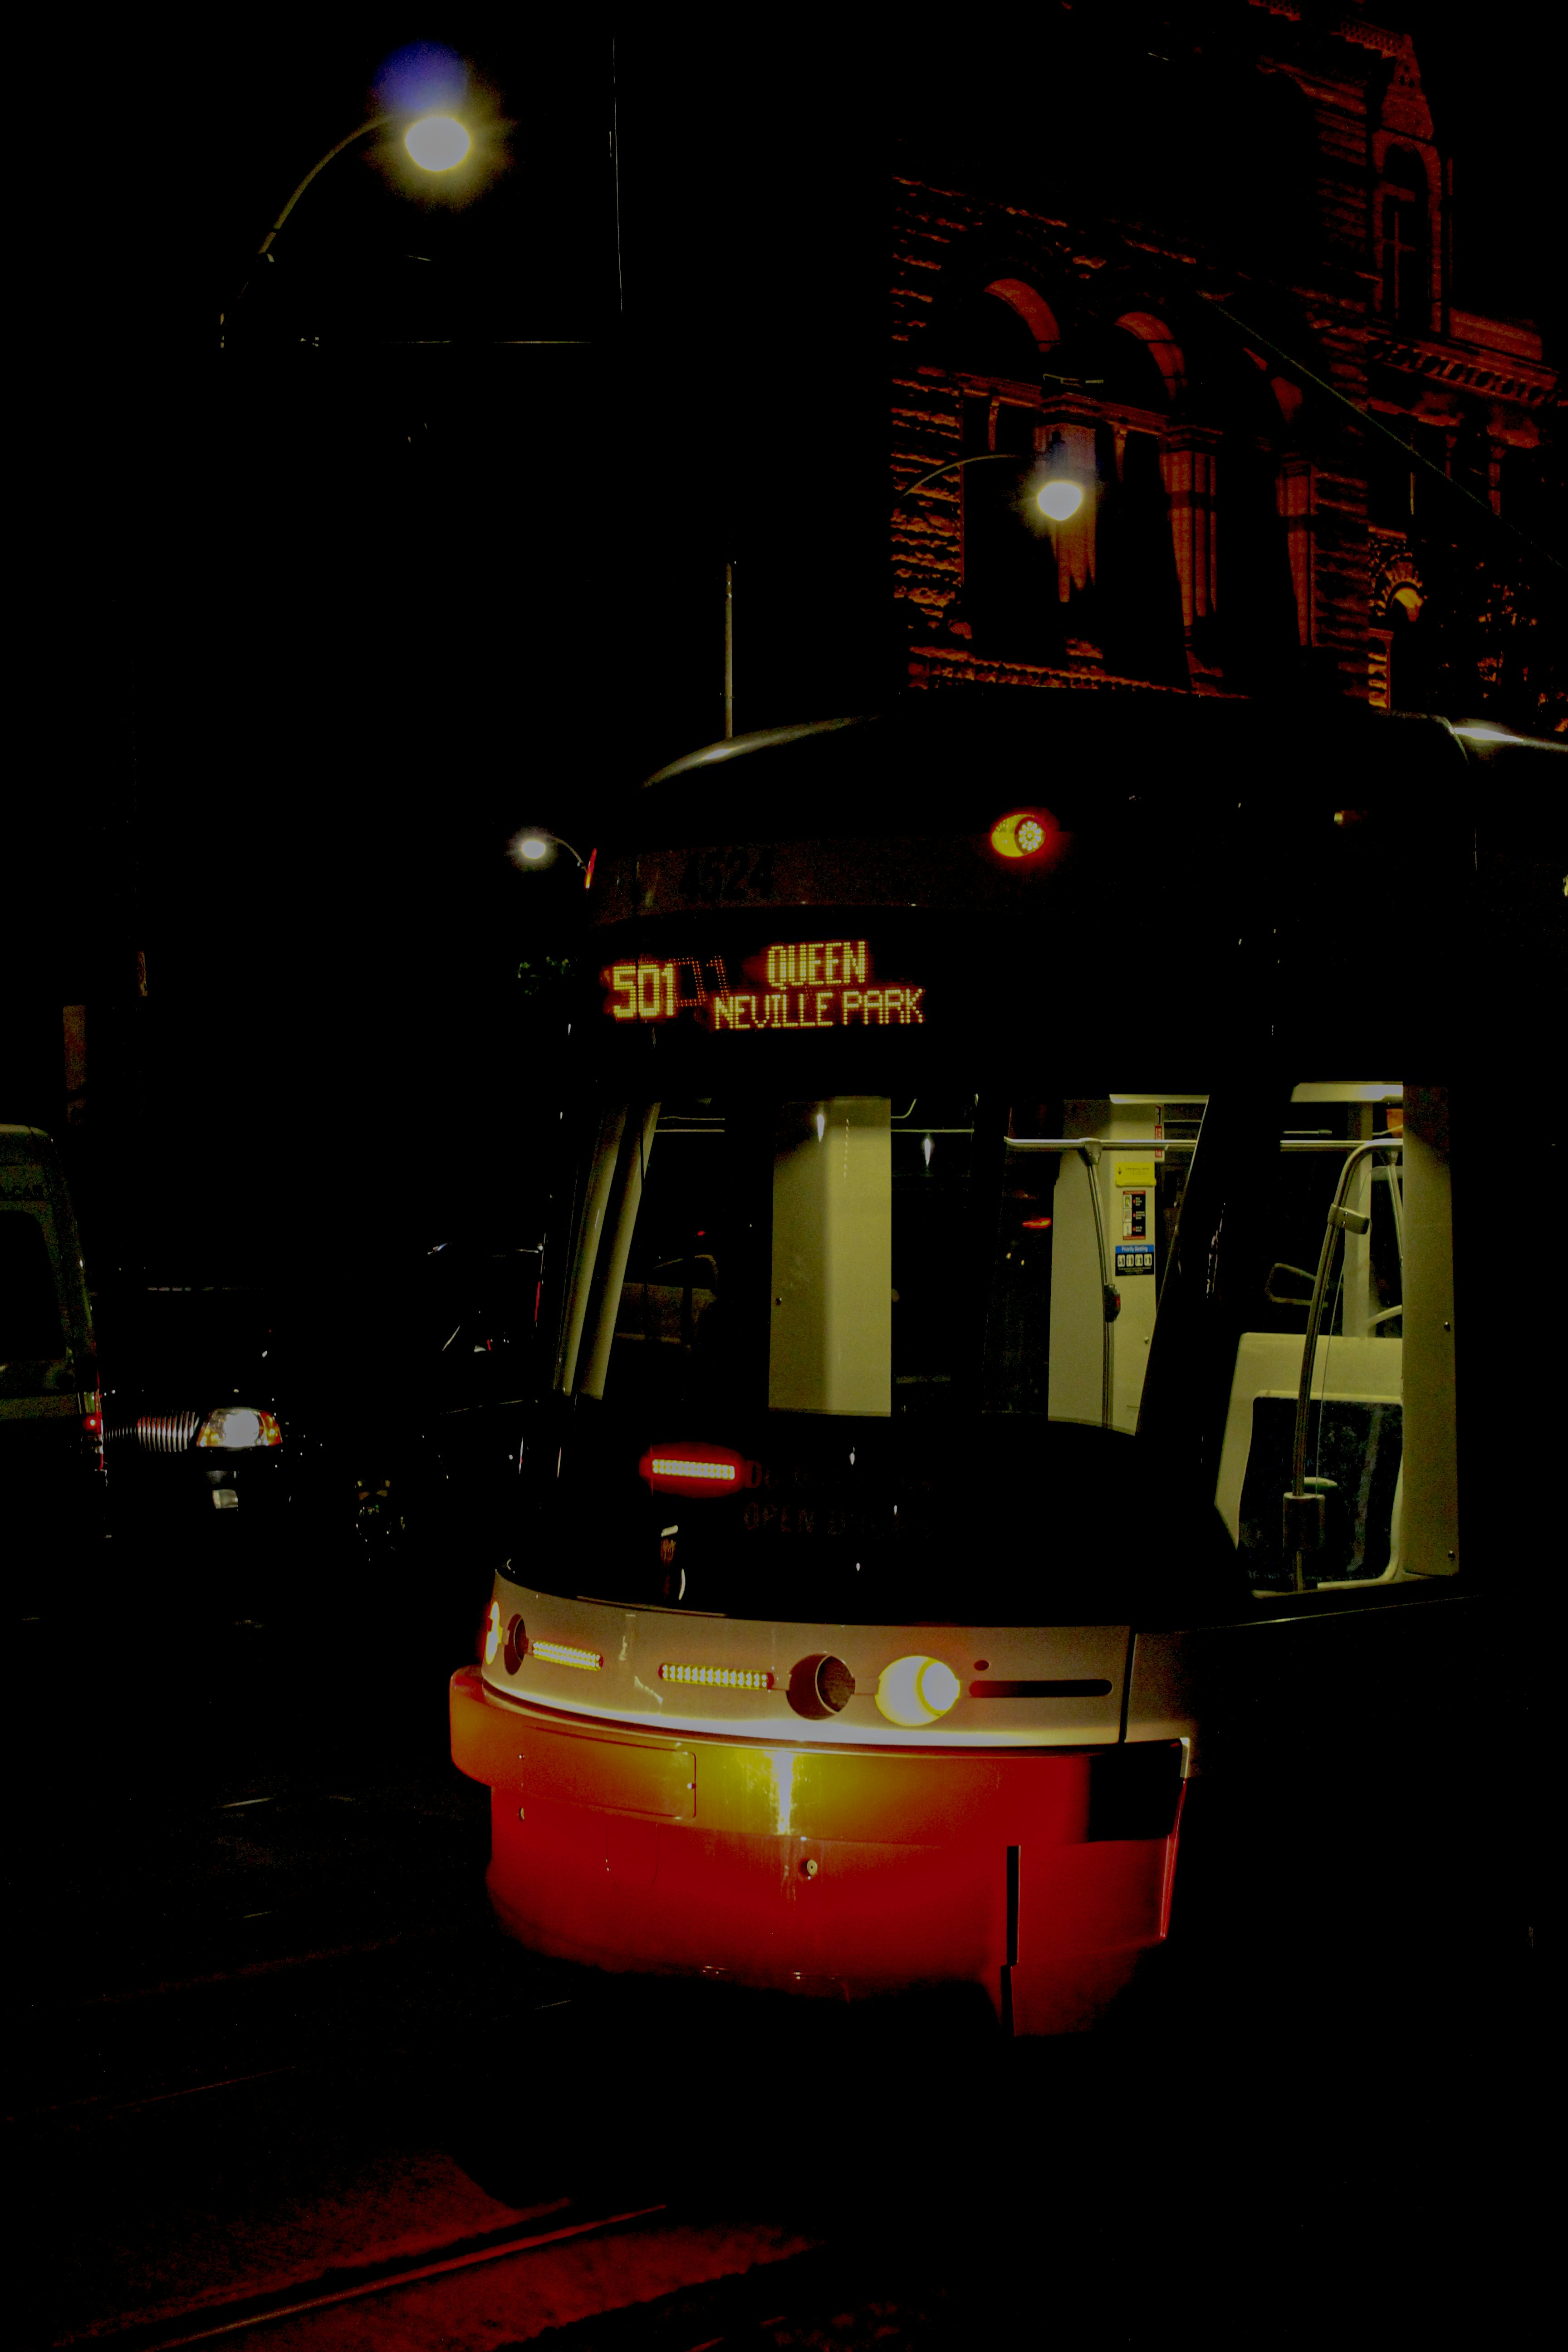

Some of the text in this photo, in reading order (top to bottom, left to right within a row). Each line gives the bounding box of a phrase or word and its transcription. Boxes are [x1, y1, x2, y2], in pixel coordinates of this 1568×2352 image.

[679, 848, 774, 900] 4524
[766, 940, 867, 990] QUEEN
[612, 963, 675, 1019] 501
[714, 988, 926, 1030] NEVILLE PARK
[743, 1502, 816, 1534] OPEN
